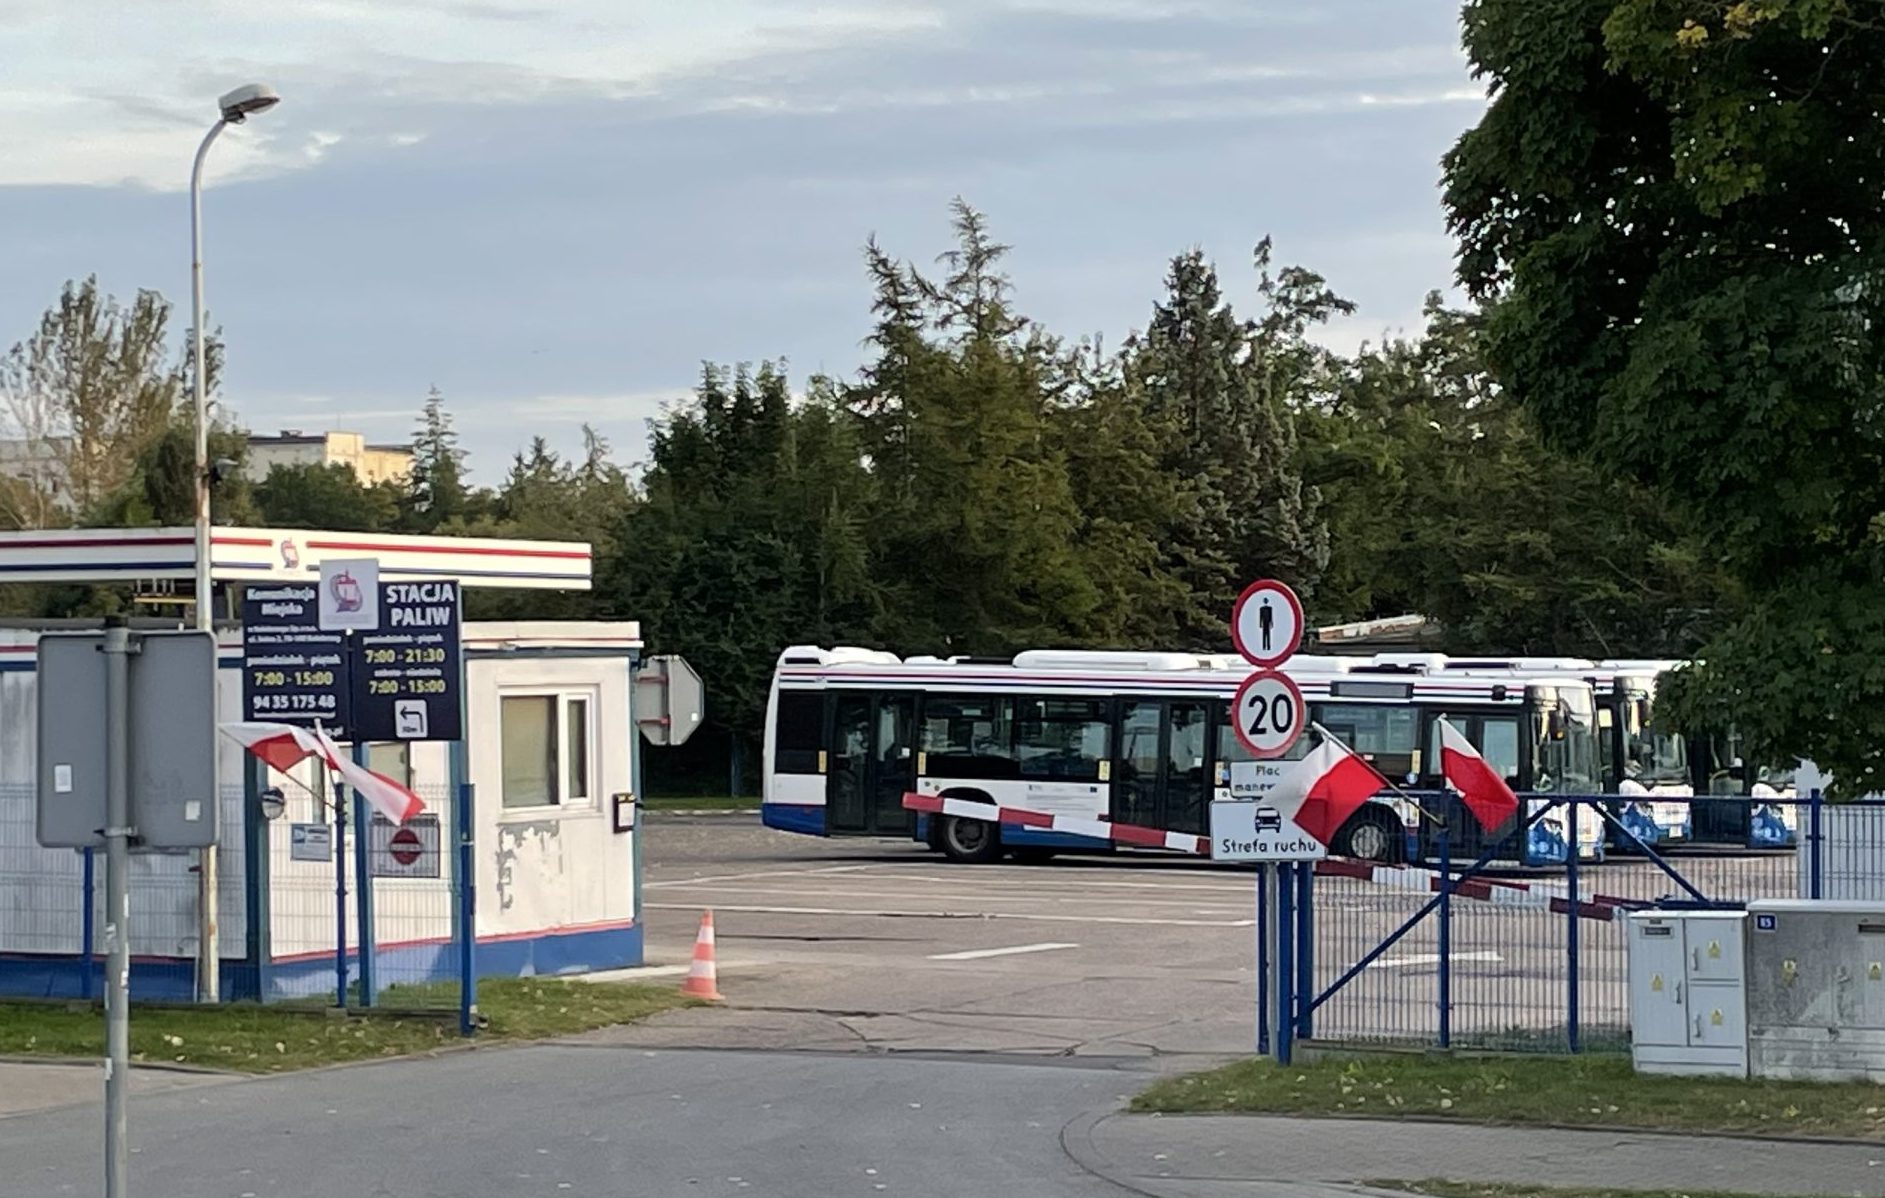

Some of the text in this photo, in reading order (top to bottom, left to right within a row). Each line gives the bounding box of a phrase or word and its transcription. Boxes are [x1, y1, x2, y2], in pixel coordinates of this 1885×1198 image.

[386, 583, 455, 604] STACJA
[391, 606, 450, 627] PALIW
[364, 649, 396, 663] 7:00
[405, 648, 445, 662] 21:30
[254, 671, 285, 686] 7:00
[294, 671, 334, 686] 15:00
[369, 679, 398, 694] 7:00
[408, 679, 446, 693] 15:00
[253, 694, 336, 709] 94 35 175 48
[1248, 693, 1293, 735] 20
[1256, 765, 1280, 776] Plac
[1222, 838, 1316, 853] Strefa ruchu
